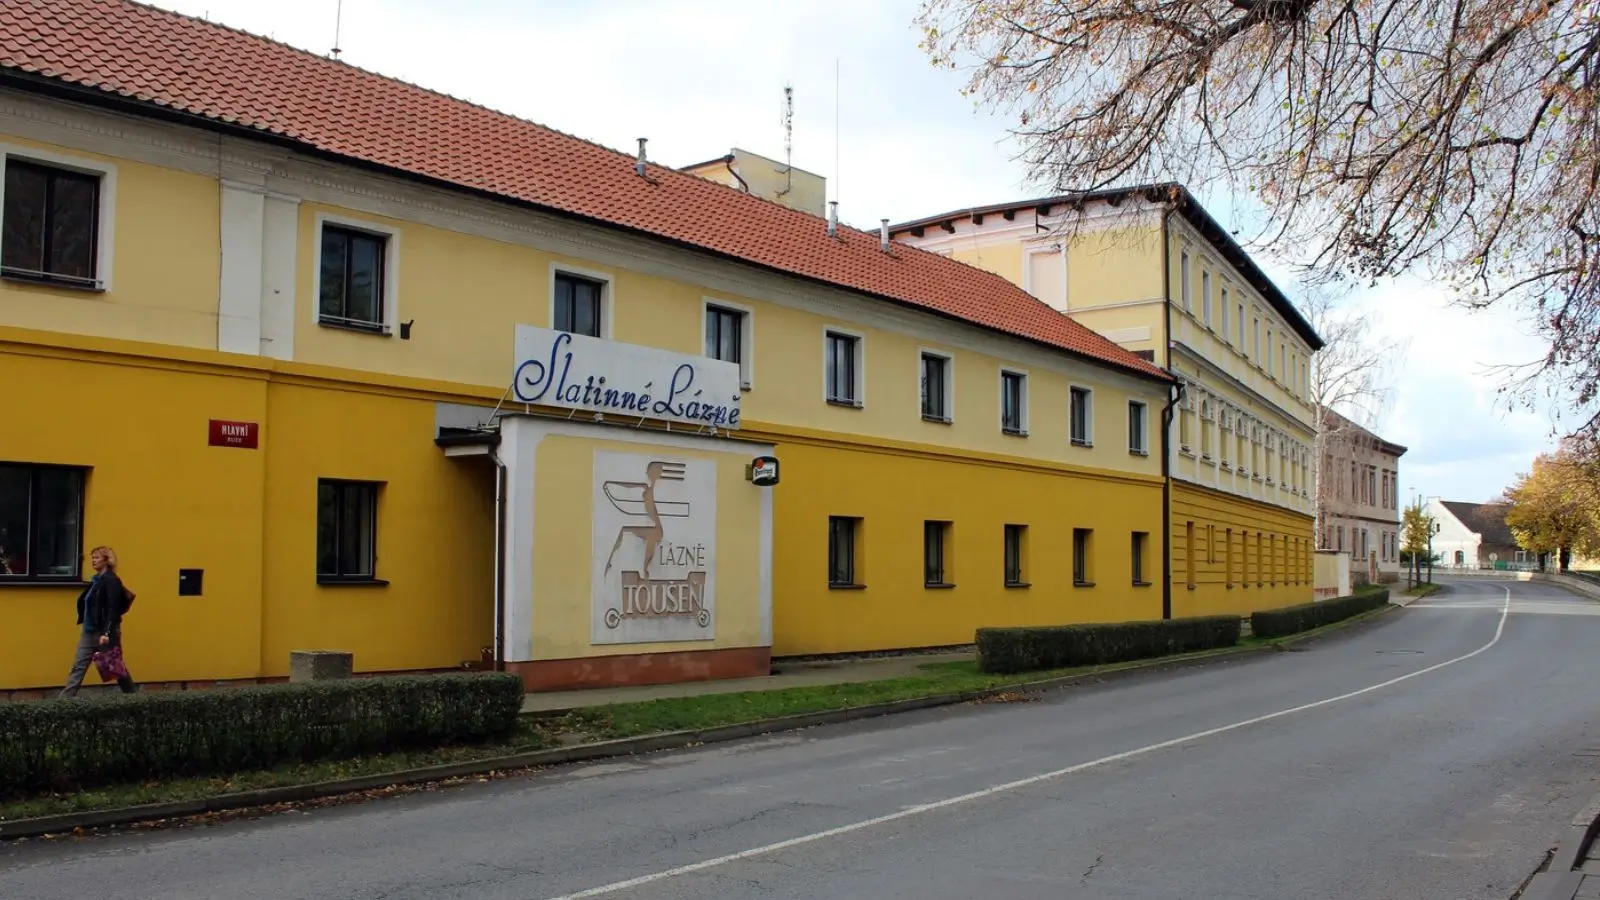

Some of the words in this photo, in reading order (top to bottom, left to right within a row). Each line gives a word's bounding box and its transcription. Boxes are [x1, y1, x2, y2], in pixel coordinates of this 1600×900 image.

[514, 333, 650, 412] Slatinné
[652, 364, 741, 425] Lázně
[222, 424, 248, 437] HLAVNÍ
[624, 580, 704, 614] TOUŠEŇ
